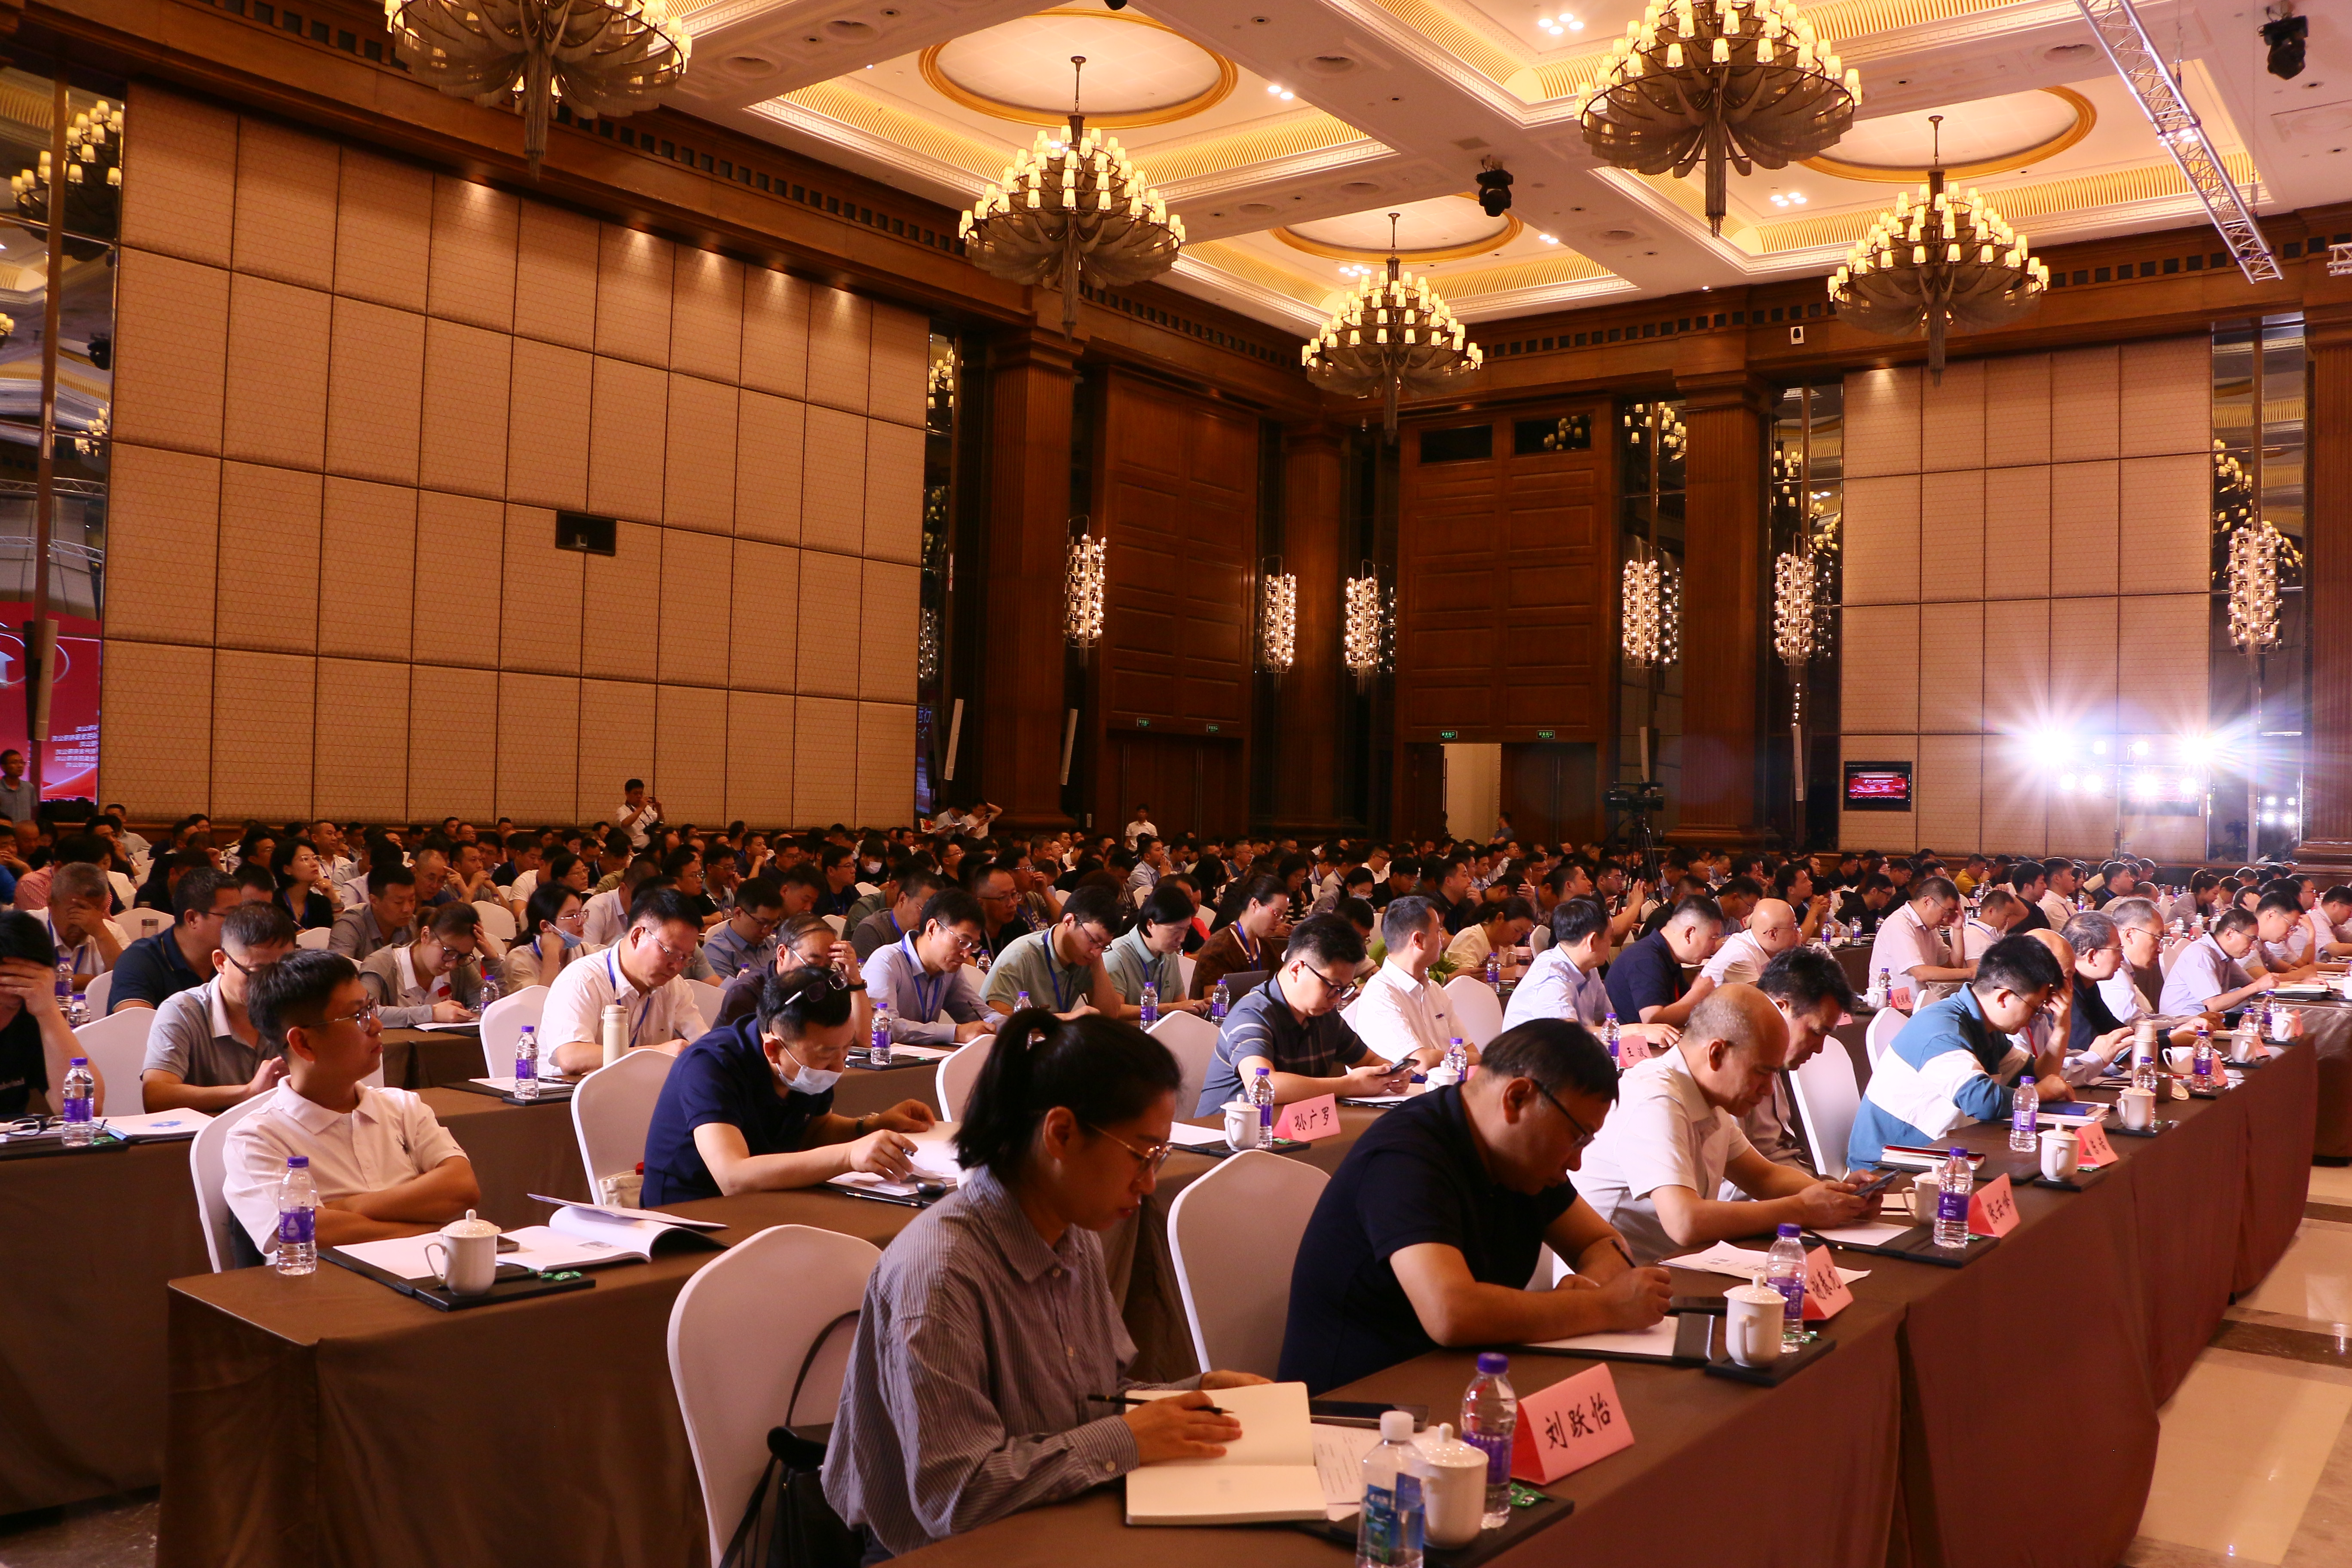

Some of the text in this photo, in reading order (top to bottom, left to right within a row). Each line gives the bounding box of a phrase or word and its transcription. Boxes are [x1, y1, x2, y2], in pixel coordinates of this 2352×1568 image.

[1295, 1106, 1329, 1130] 孙广罗
[1546, 1393, 1611, 1449] 刘跃怡
